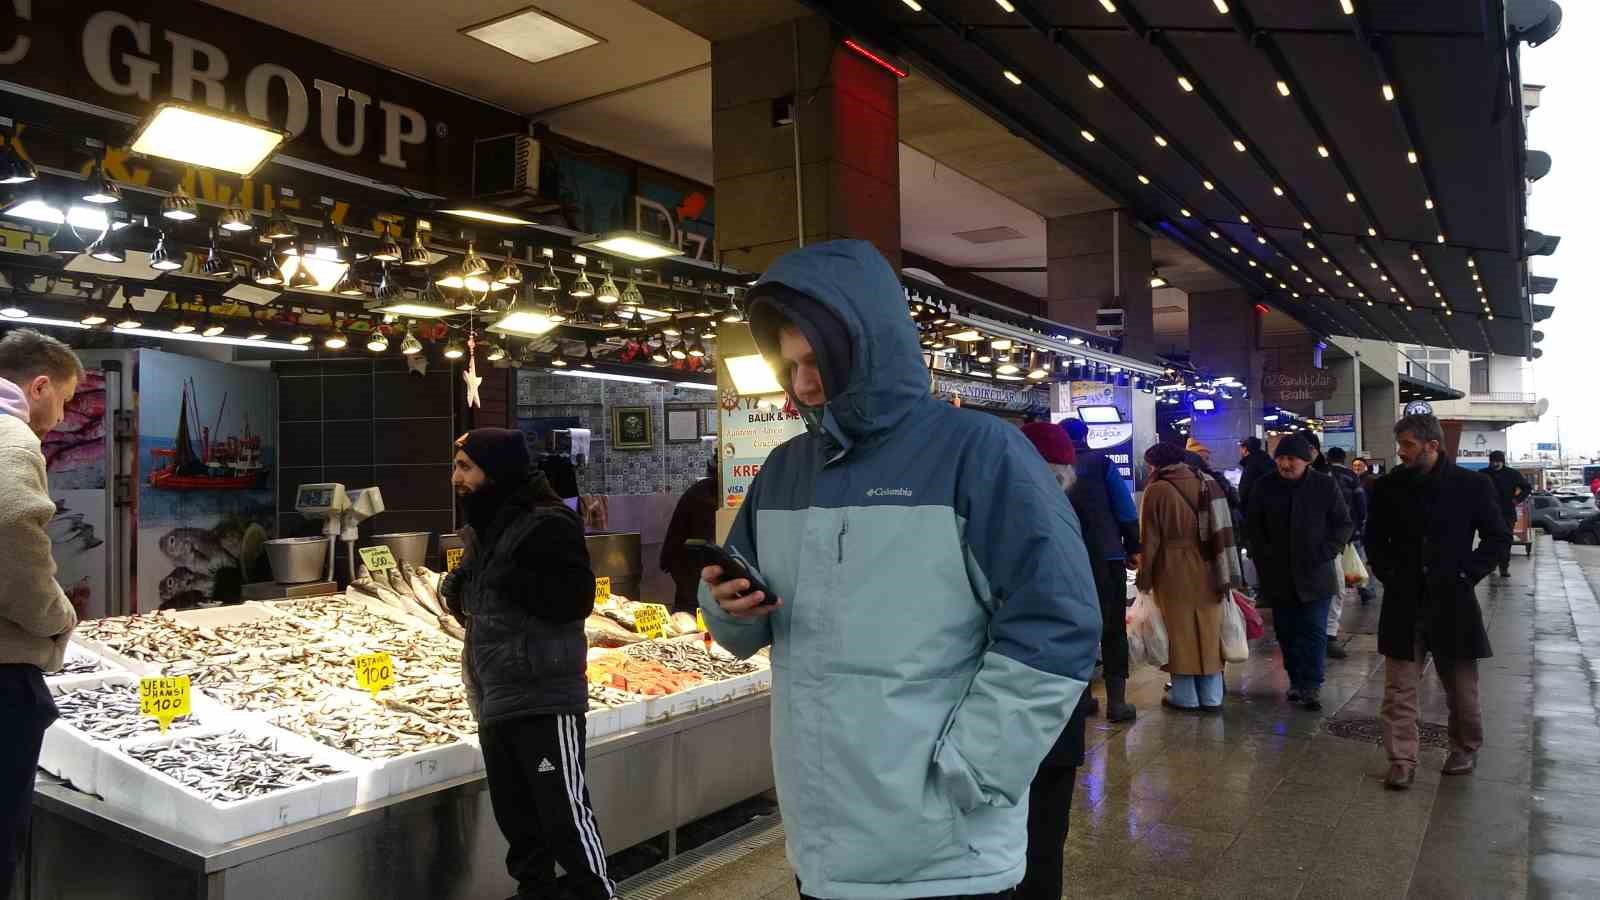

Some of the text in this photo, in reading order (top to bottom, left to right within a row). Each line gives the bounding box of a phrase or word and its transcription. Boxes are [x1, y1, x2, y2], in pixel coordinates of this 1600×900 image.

[81, 9, 428, 169] GROUP
[748, 411, 775, 423] BALIK
[727, 485, 744, 494] VISA
[874, 487, 913, 497] Columbia
[362, 665, 390, 685] 100
